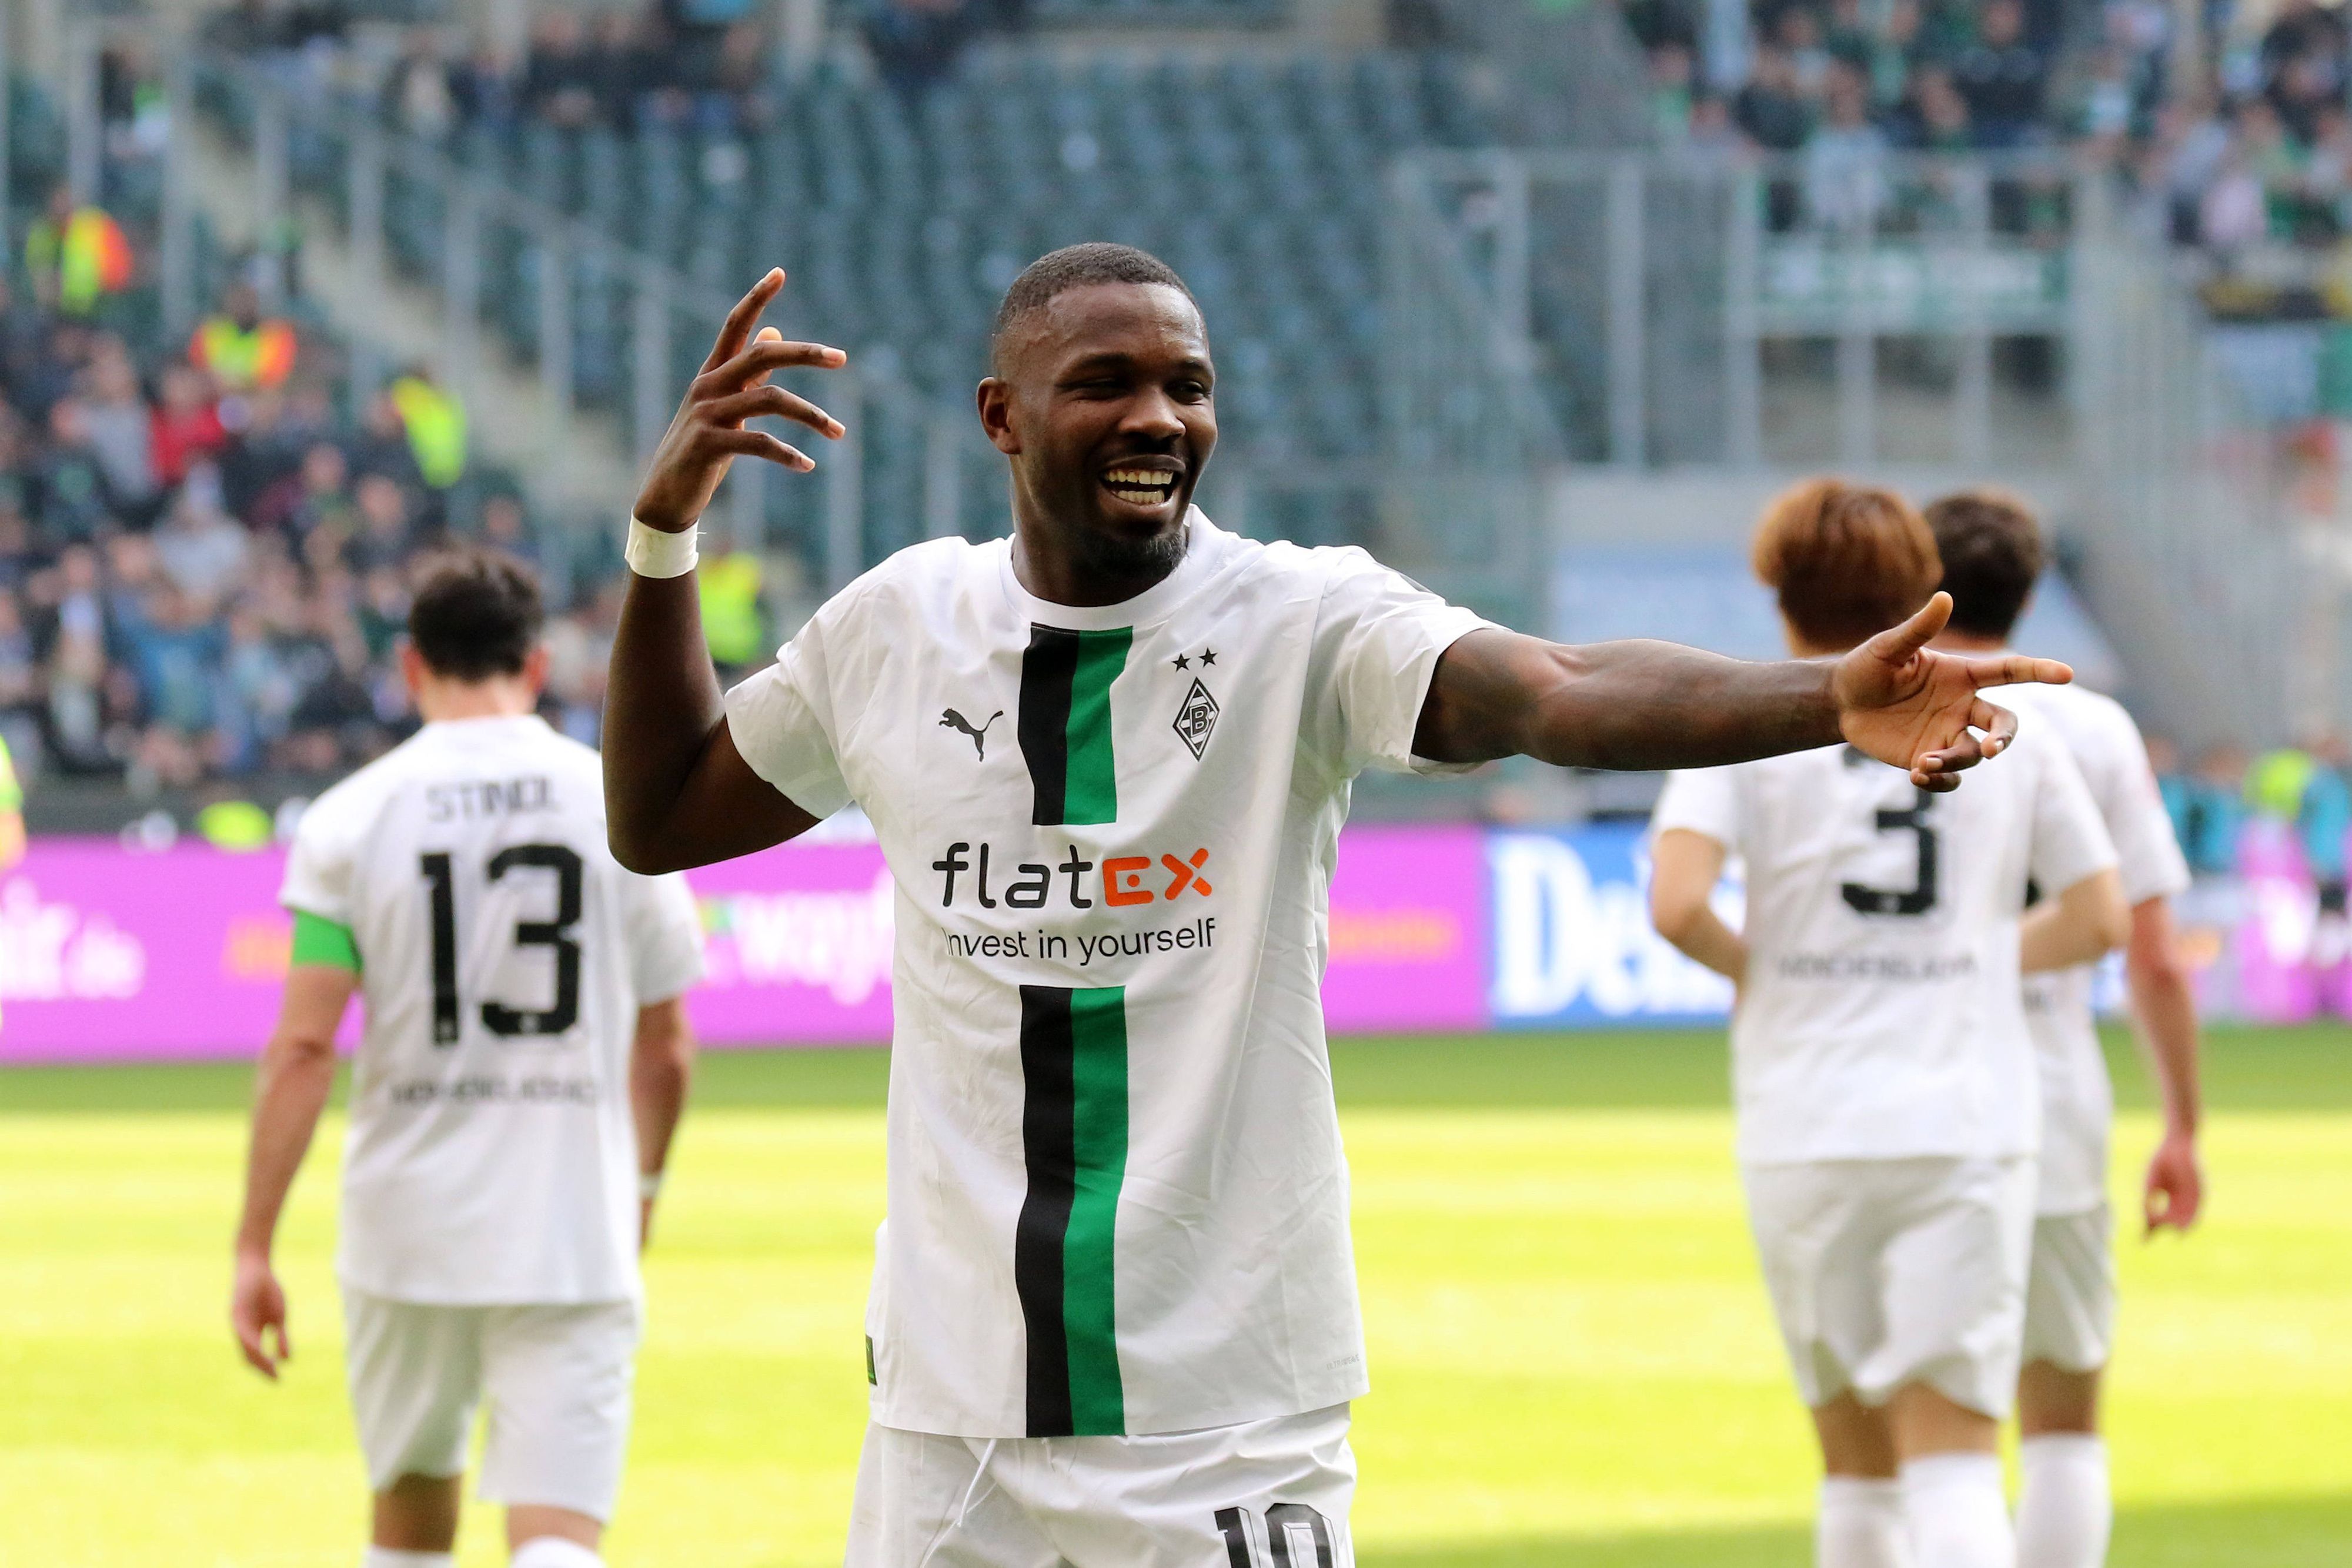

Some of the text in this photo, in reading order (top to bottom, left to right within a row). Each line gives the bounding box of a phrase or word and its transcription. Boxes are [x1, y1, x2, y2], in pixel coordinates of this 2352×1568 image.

[1190, 704, 1210, 737] B
[1840, 744, 1936, 914] 3
[421, 845, 583, 1045] 13
[1038, 929, 1067, 958] in
[1077, 918, 1216, 966] yourself
[1214, 1503, 1338, 1568] 10
